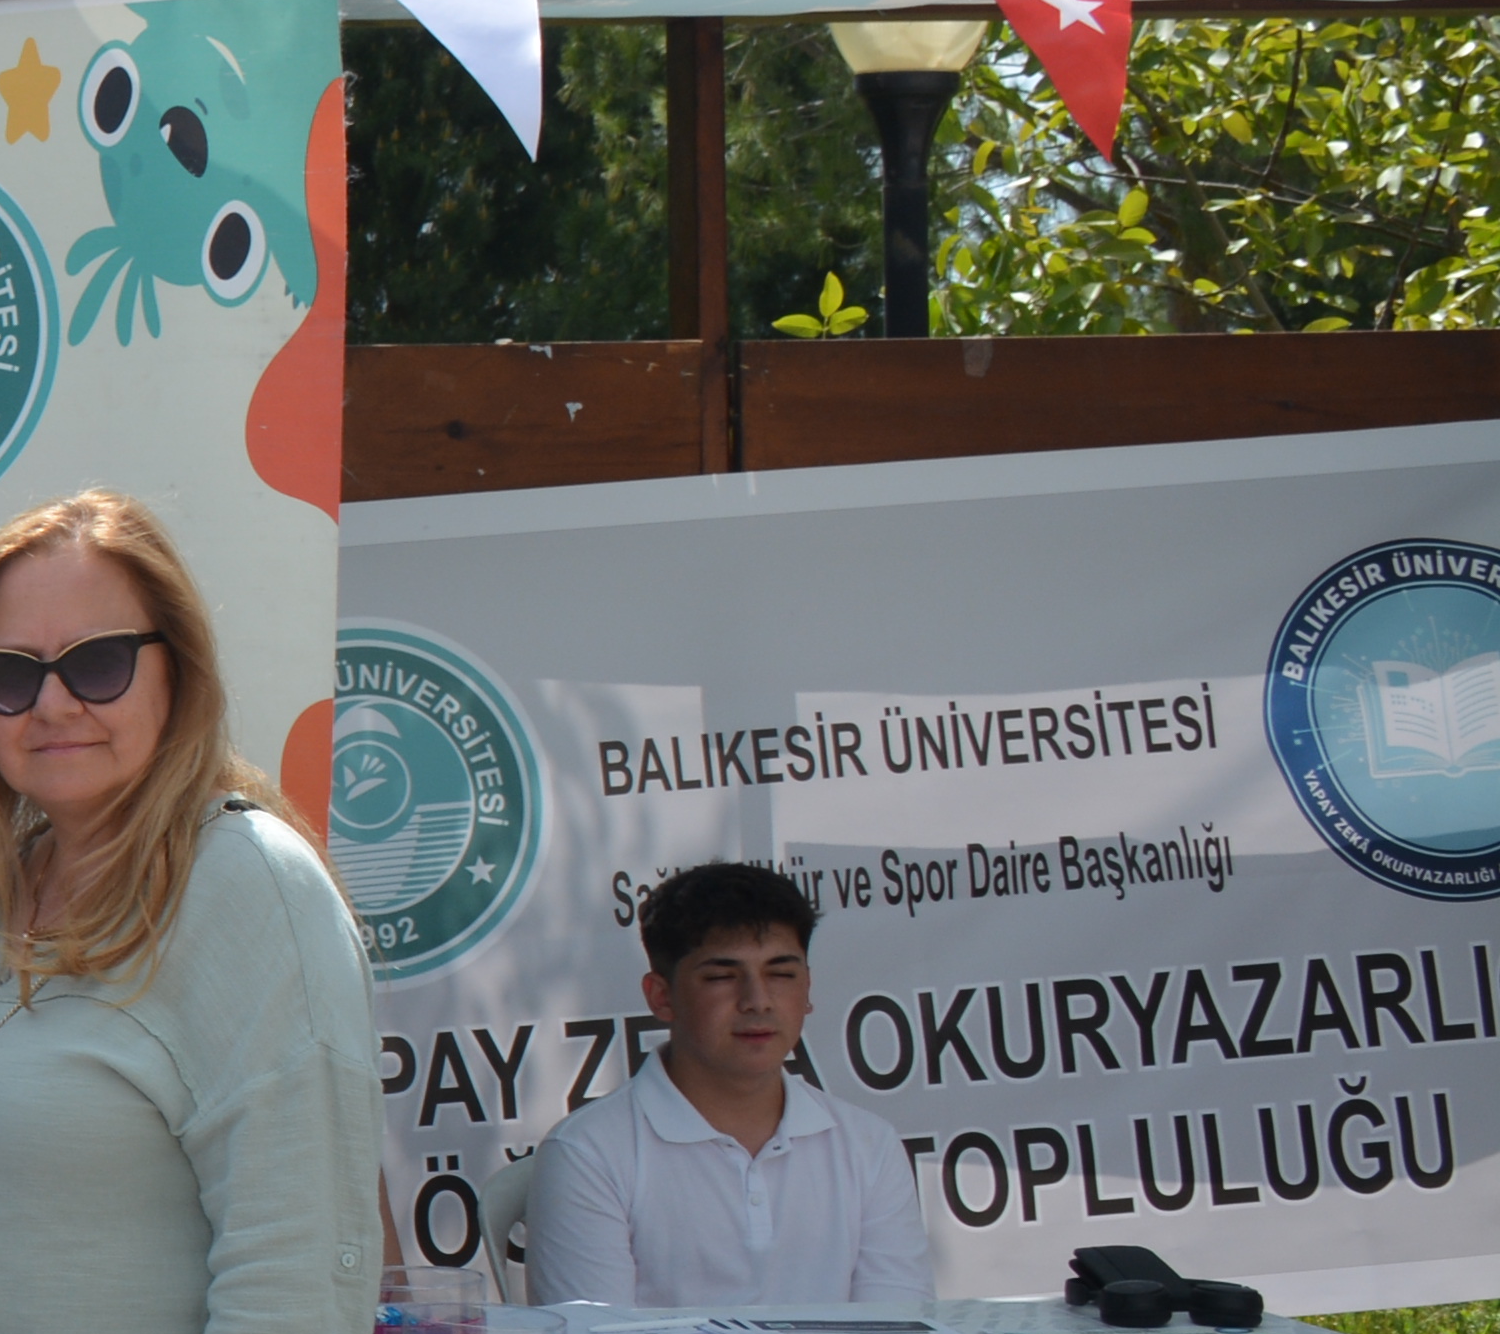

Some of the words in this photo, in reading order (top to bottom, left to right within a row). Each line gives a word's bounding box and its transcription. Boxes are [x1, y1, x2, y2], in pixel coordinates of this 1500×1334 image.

[1282, 562, 1386, 682] BALIKESİR
[335, 659, 509, 827] ÜNİVERSİTESİ
[598, 712, 868, 796] BALIKESİR
[879, 682, 1218, 774] ÜNİVERSİTESİ
[835, 868, 871, 909] ve
[880, 847, 958, 918] Spor
[966, 839, 1051, 899] Daire
[1058, 821, 1235, 900] Başkanlığı
[1303, 768, 1338, 818] YAPAY
[1334, 815, 1369, 854] ZEKÂ
[1371, 848, 1496, 885] OKURYAZARLIĞI
[359, 916, 420, 950] 992
